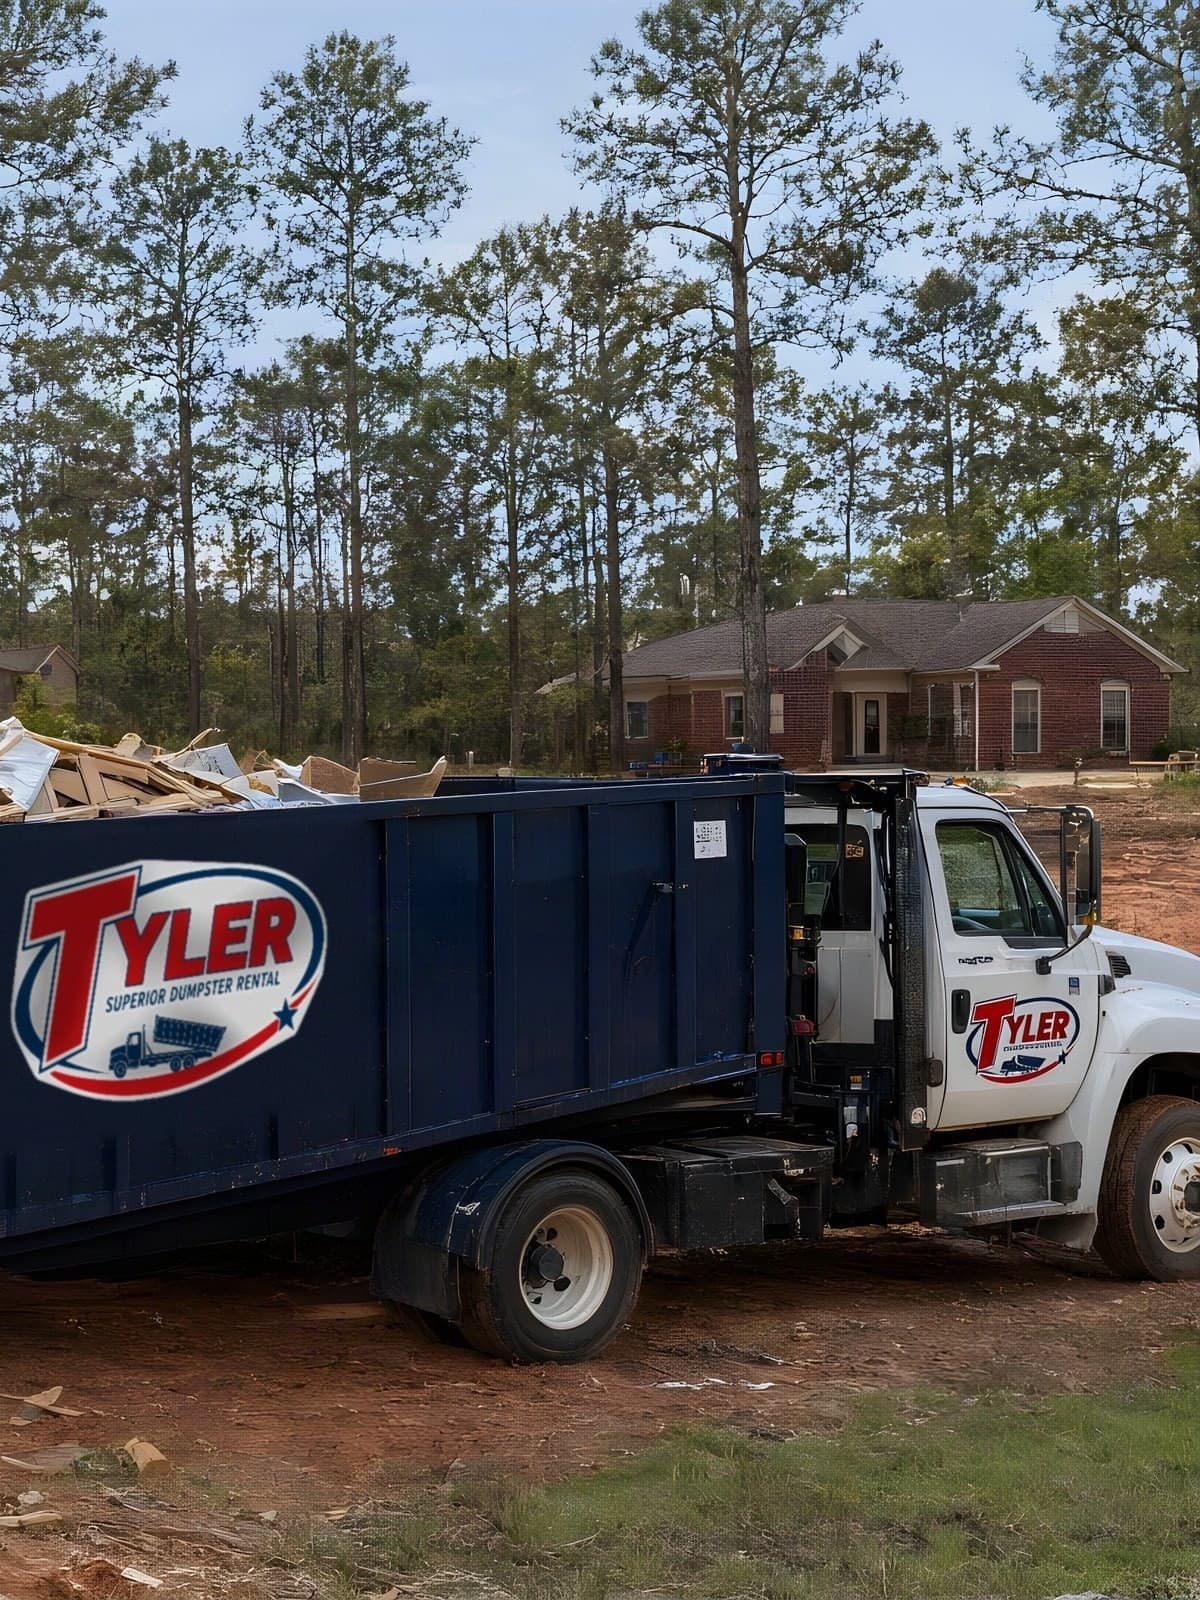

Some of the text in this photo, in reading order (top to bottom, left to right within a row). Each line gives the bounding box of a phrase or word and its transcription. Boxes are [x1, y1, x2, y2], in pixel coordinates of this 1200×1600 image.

[27, 872, 297, 1066] TYLER
[105, 970, 281, 1013] SUPERIOR DUMPSTER RENTAL
[972, 996, 1070, 1070] TYLER
